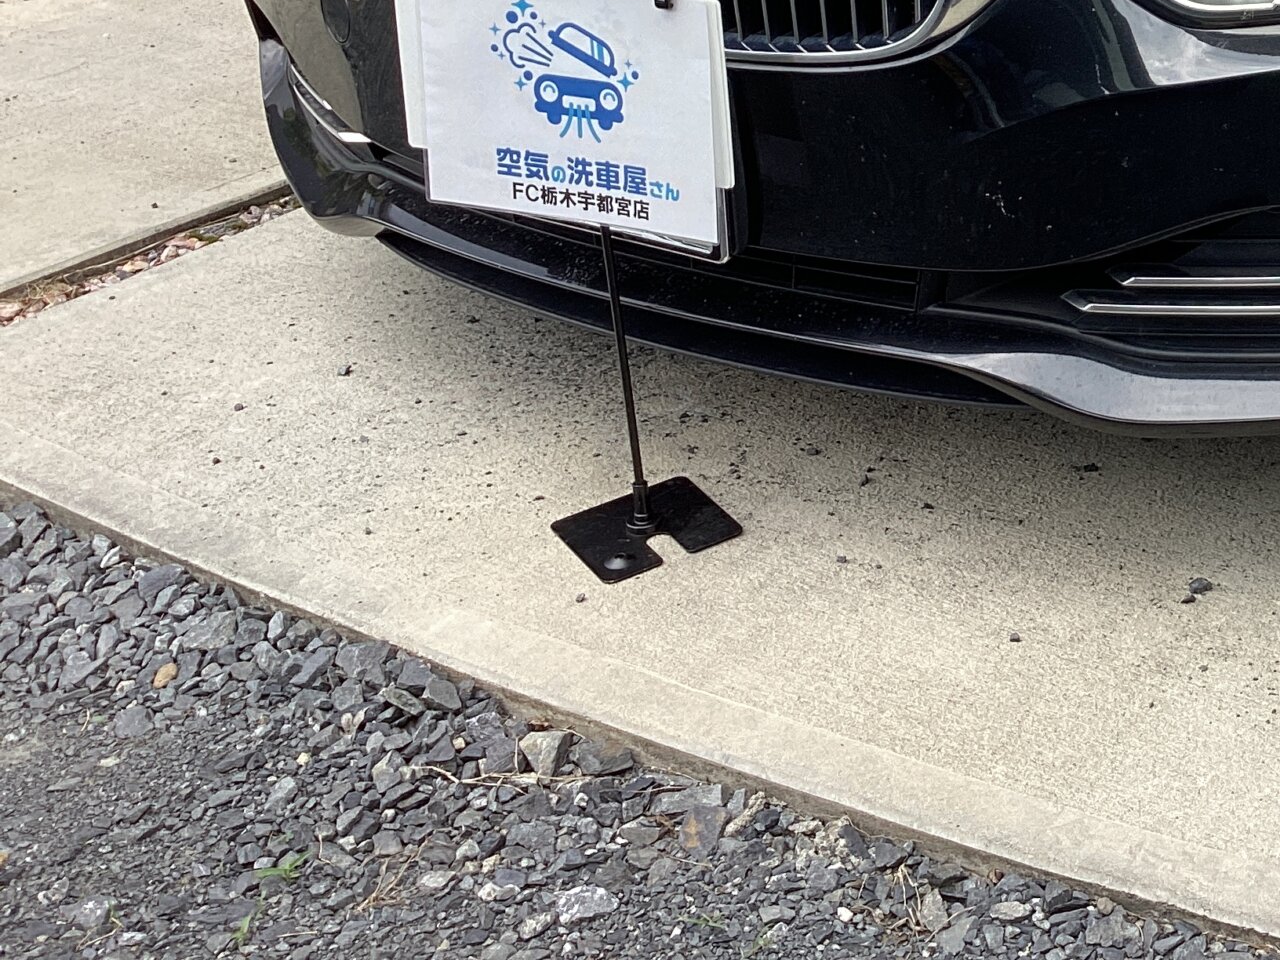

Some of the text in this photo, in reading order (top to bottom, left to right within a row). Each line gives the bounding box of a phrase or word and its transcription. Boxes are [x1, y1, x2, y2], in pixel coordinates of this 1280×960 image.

[496, 147, 680, 202] 空気の洗車屋さん
[512, 182, 650, 221] FC栃木宇都宮店
